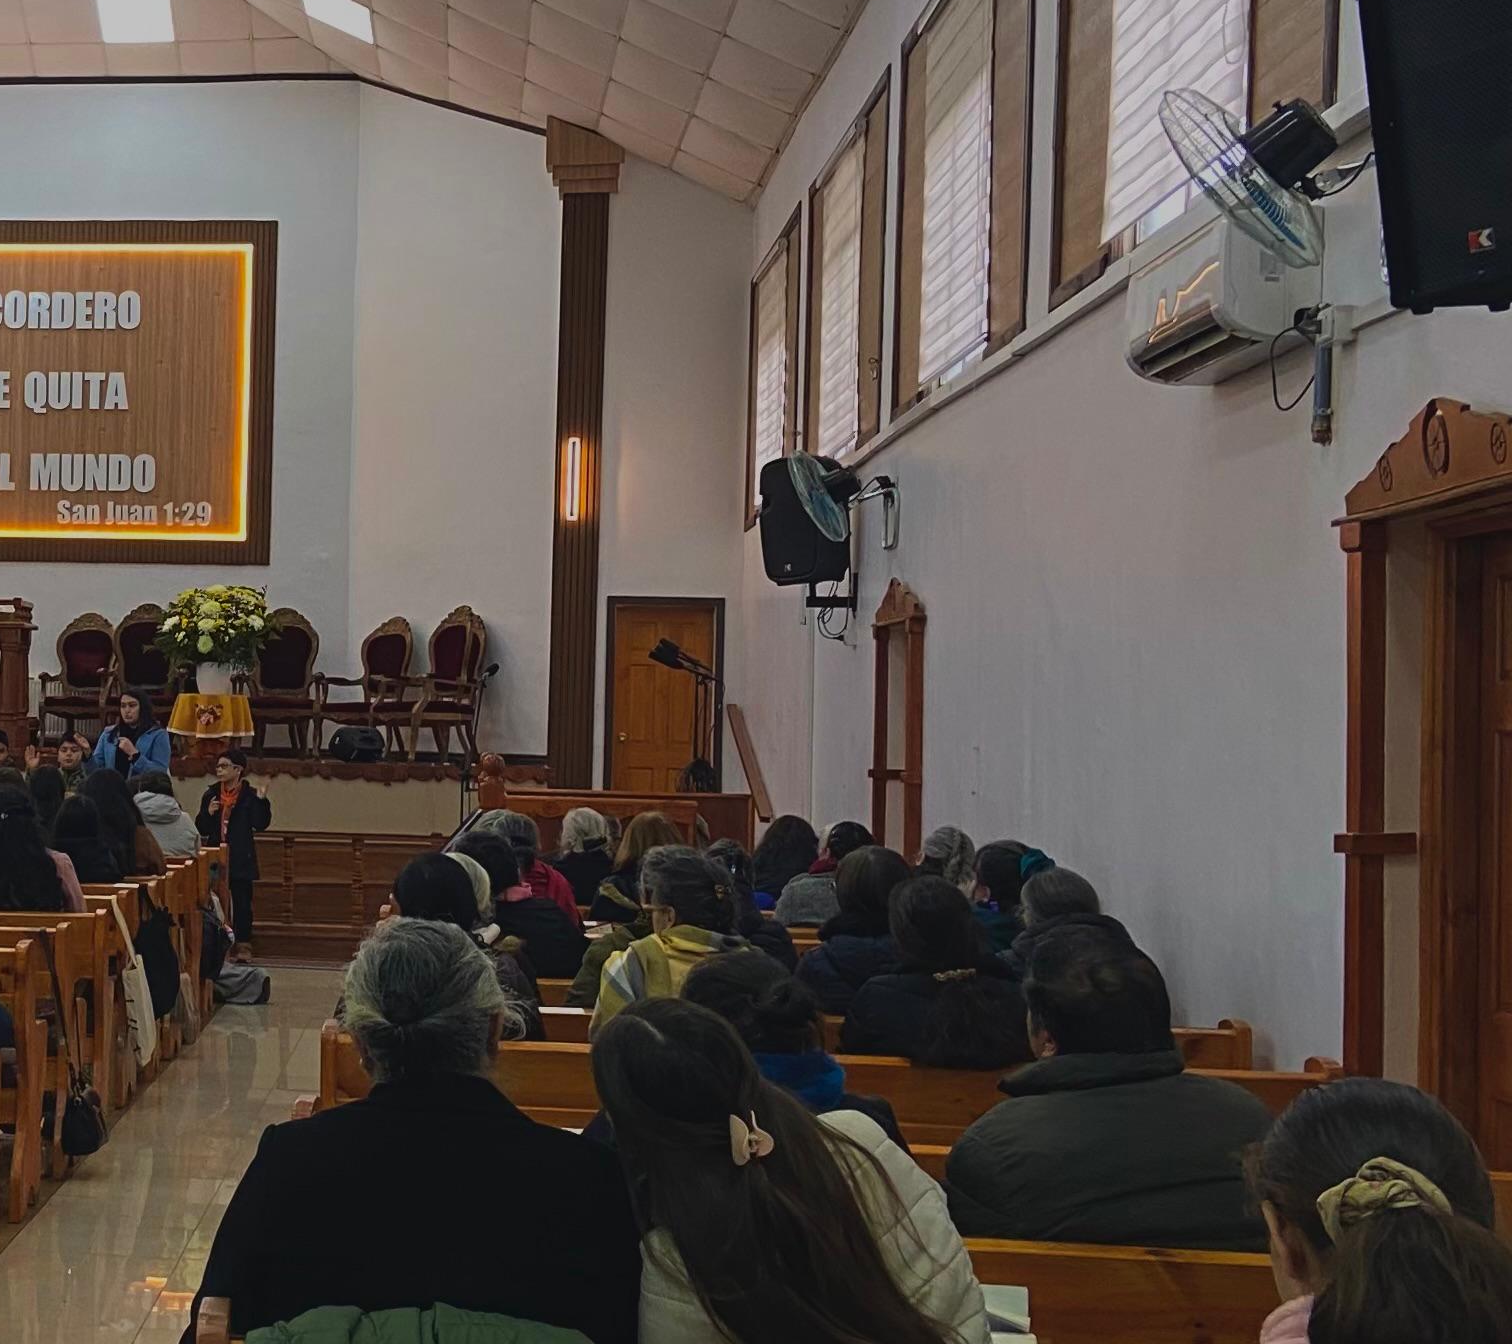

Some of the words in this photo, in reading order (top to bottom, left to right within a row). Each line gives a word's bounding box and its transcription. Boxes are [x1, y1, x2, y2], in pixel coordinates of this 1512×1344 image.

[24, 371, 129, 414] QUITA
[29, 453, 156, 493] MUNDO
[57, 499, 101, 525] San
[104, 500, 159, 526] Juan
[163, 501, 212, 527] 1:29
